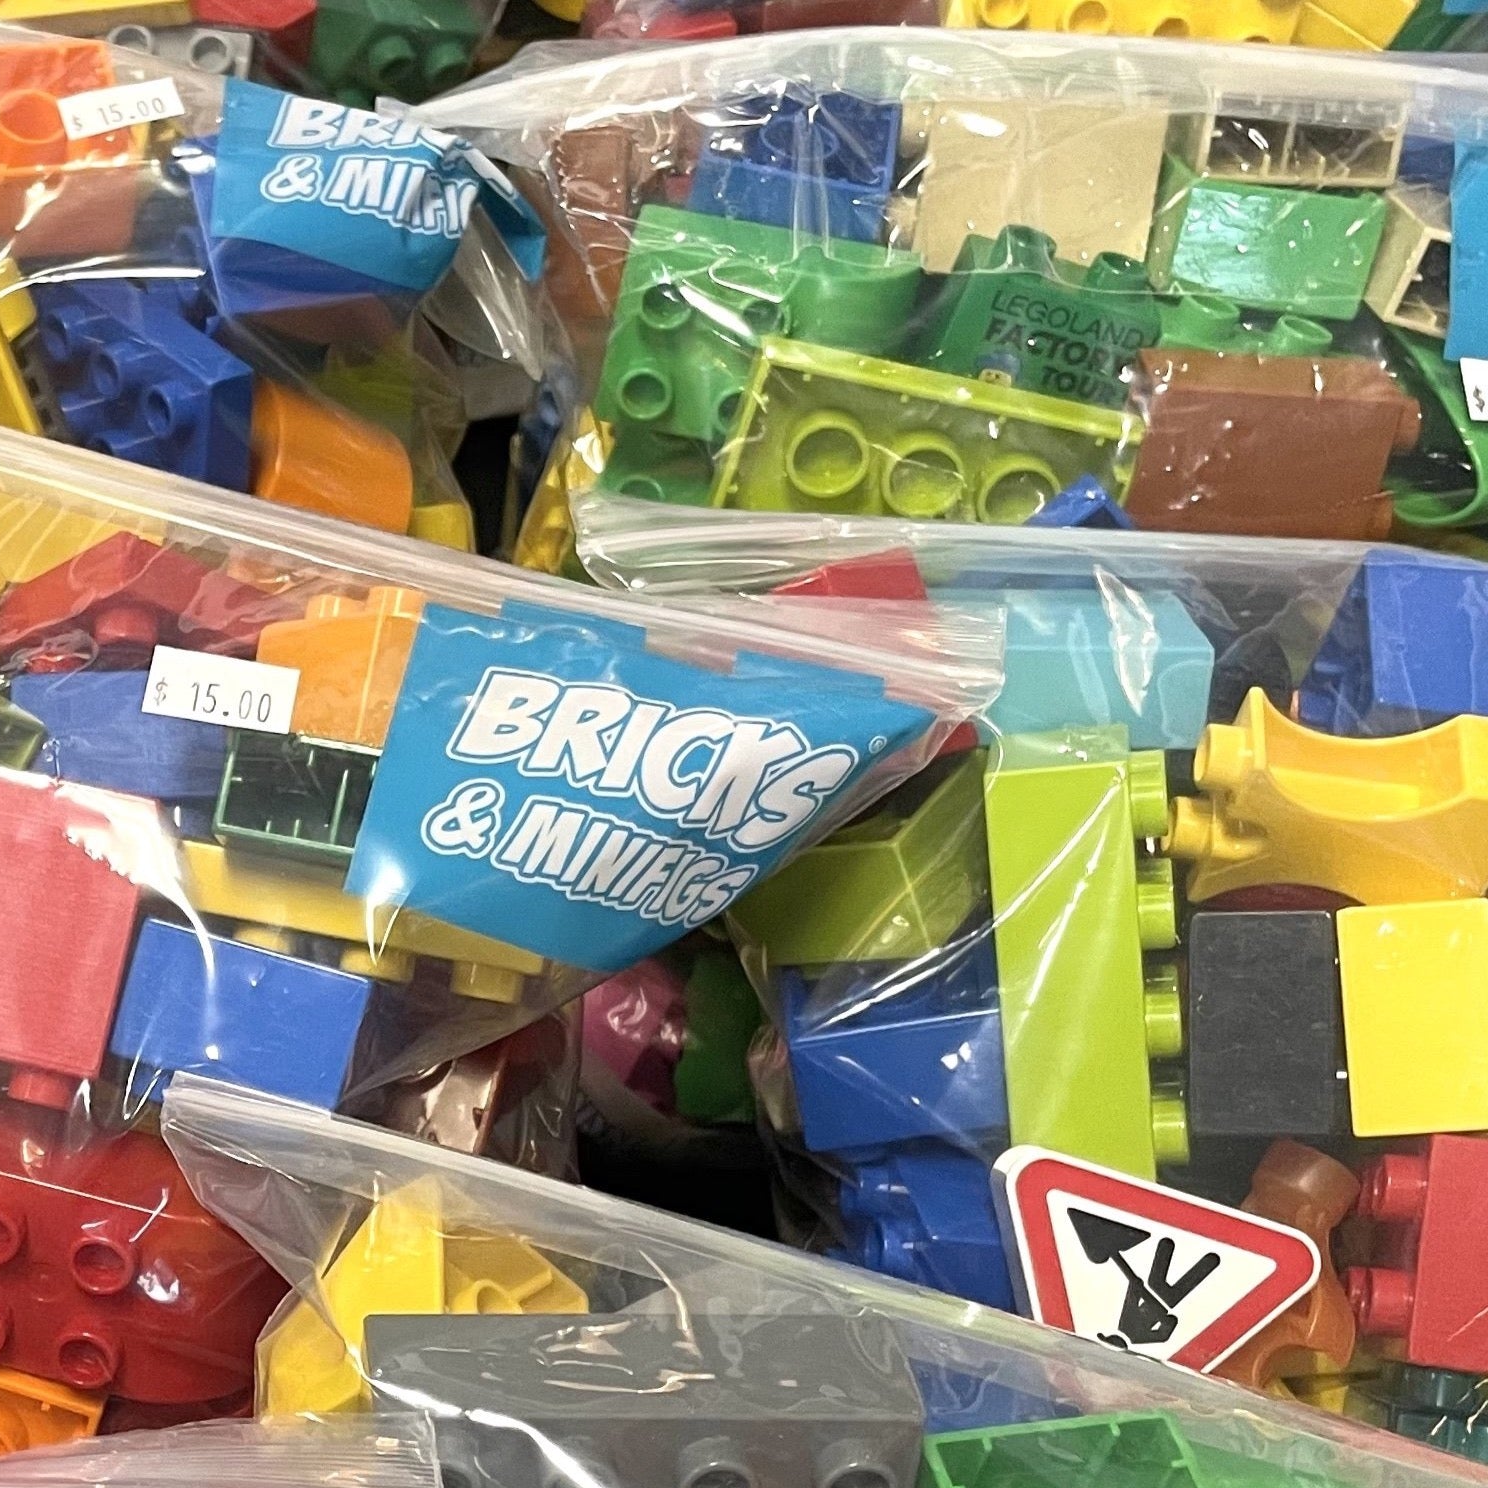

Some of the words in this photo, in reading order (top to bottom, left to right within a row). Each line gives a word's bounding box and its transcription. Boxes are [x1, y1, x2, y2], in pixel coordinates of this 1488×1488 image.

[97, 97, 166, 126] 15.00
[261, 153, 324, 203] &
[990, 289, 1145, 350] LEGOLAND
[154, 676, 169, 707] $
[190, 681, 273, 723] 15.00
[446, 667, 860, 853] BRICKS
[421, 778, 506, 857] &
[491, 796, 760, 928] MINIFIGS
